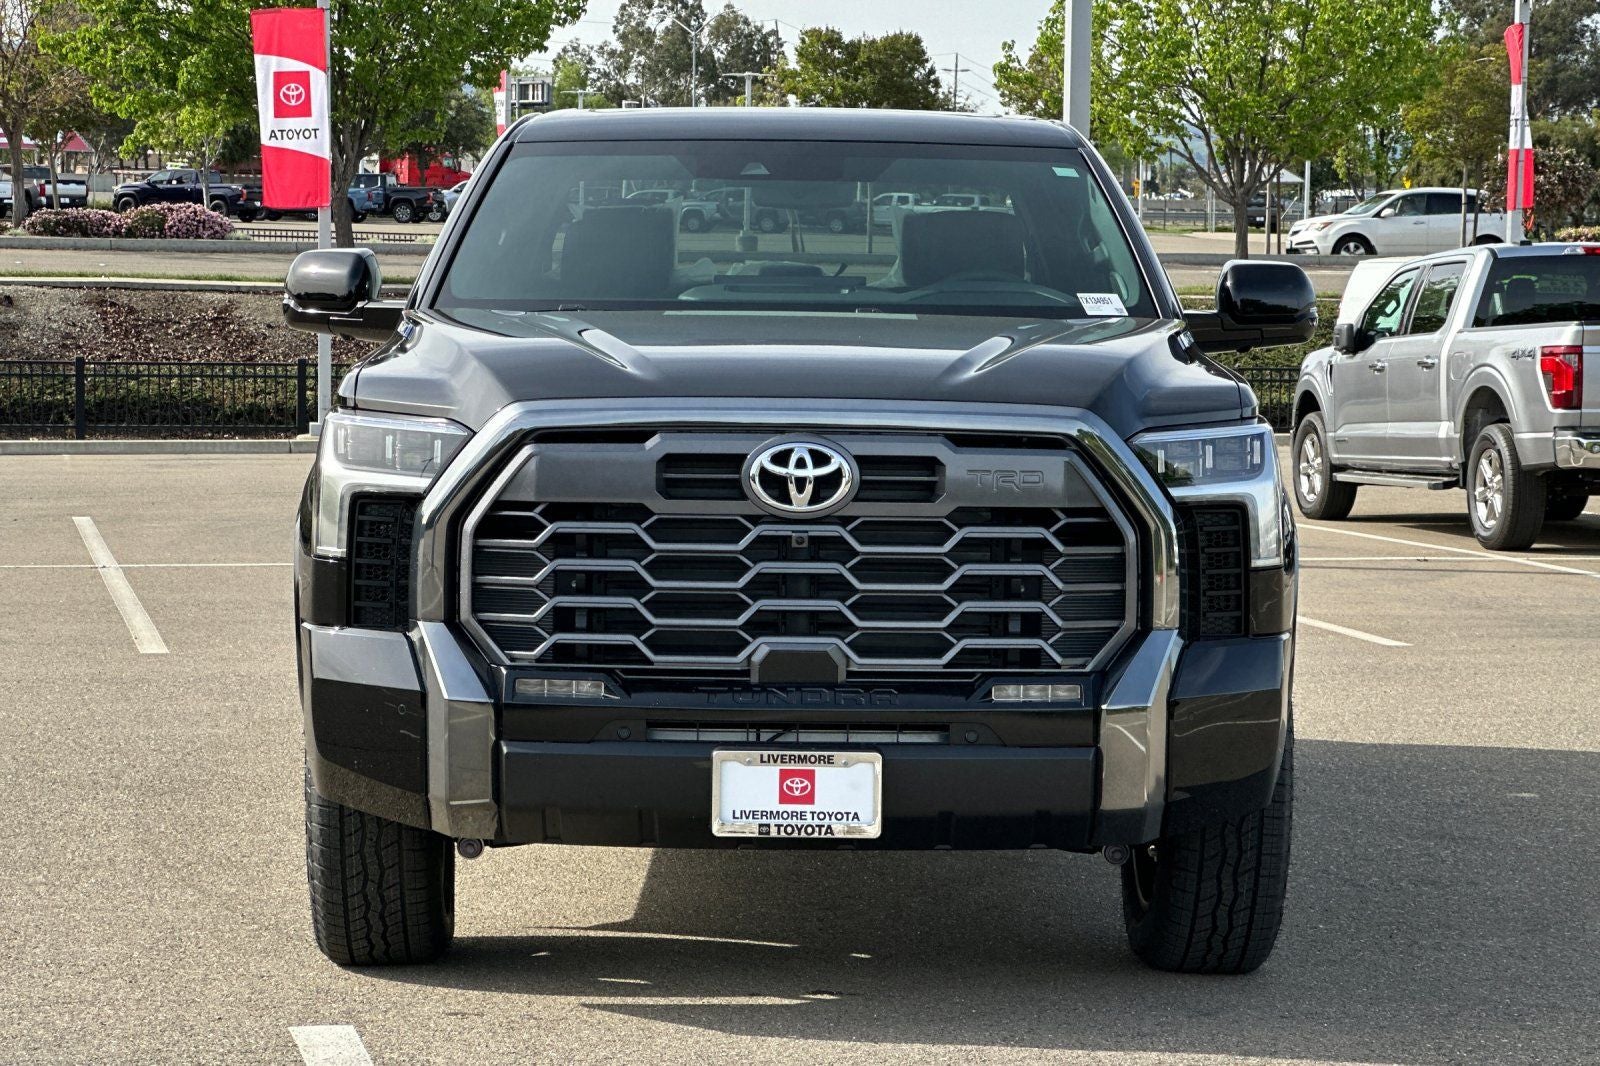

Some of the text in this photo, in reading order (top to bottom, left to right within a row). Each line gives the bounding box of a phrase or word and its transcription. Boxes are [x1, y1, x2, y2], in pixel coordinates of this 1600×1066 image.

[966, 468, 1044, 493] TRD
[697, 687, 900, 706] TUNDRA
[759, 754, 835, 765] LIVERMORE
[732, 809, 860, 822] LIVERMORE TOYOTA
[774, 823, 835, 836] TOYOTA
